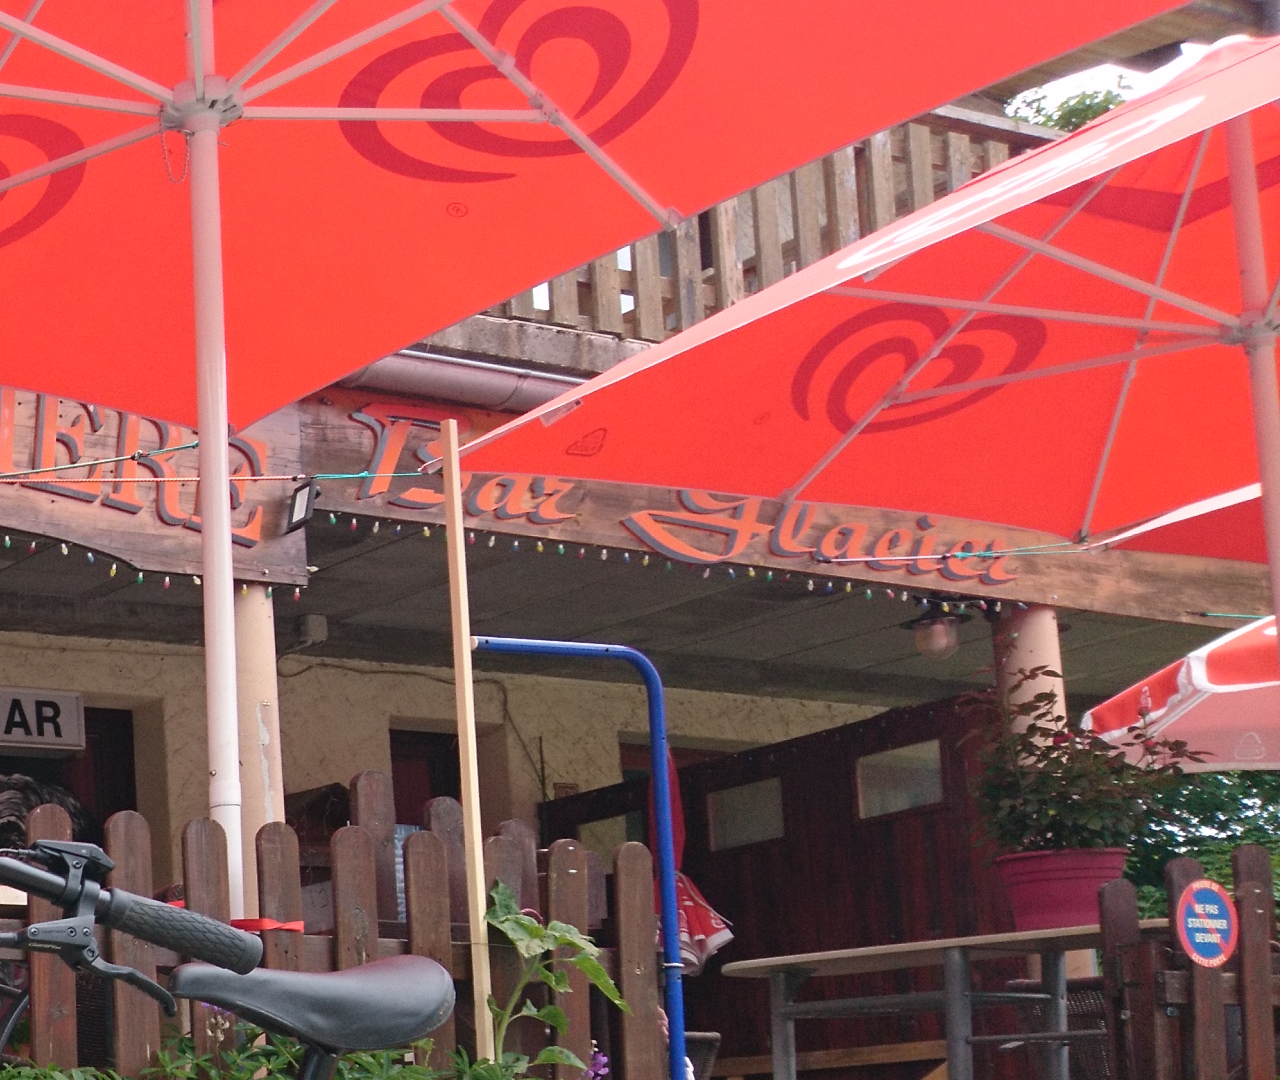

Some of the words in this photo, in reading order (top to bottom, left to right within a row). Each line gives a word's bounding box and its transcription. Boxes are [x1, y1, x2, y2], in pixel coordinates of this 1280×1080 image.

[621, 489, 1020, 586] Glacier
[1195, 904, 1205, 914] NE
[1206, 904, 1219, 915] PAS
[1187, 918, 1228, 929] STATIONNER
[1195, 933, 1221, 943] DEVANT
